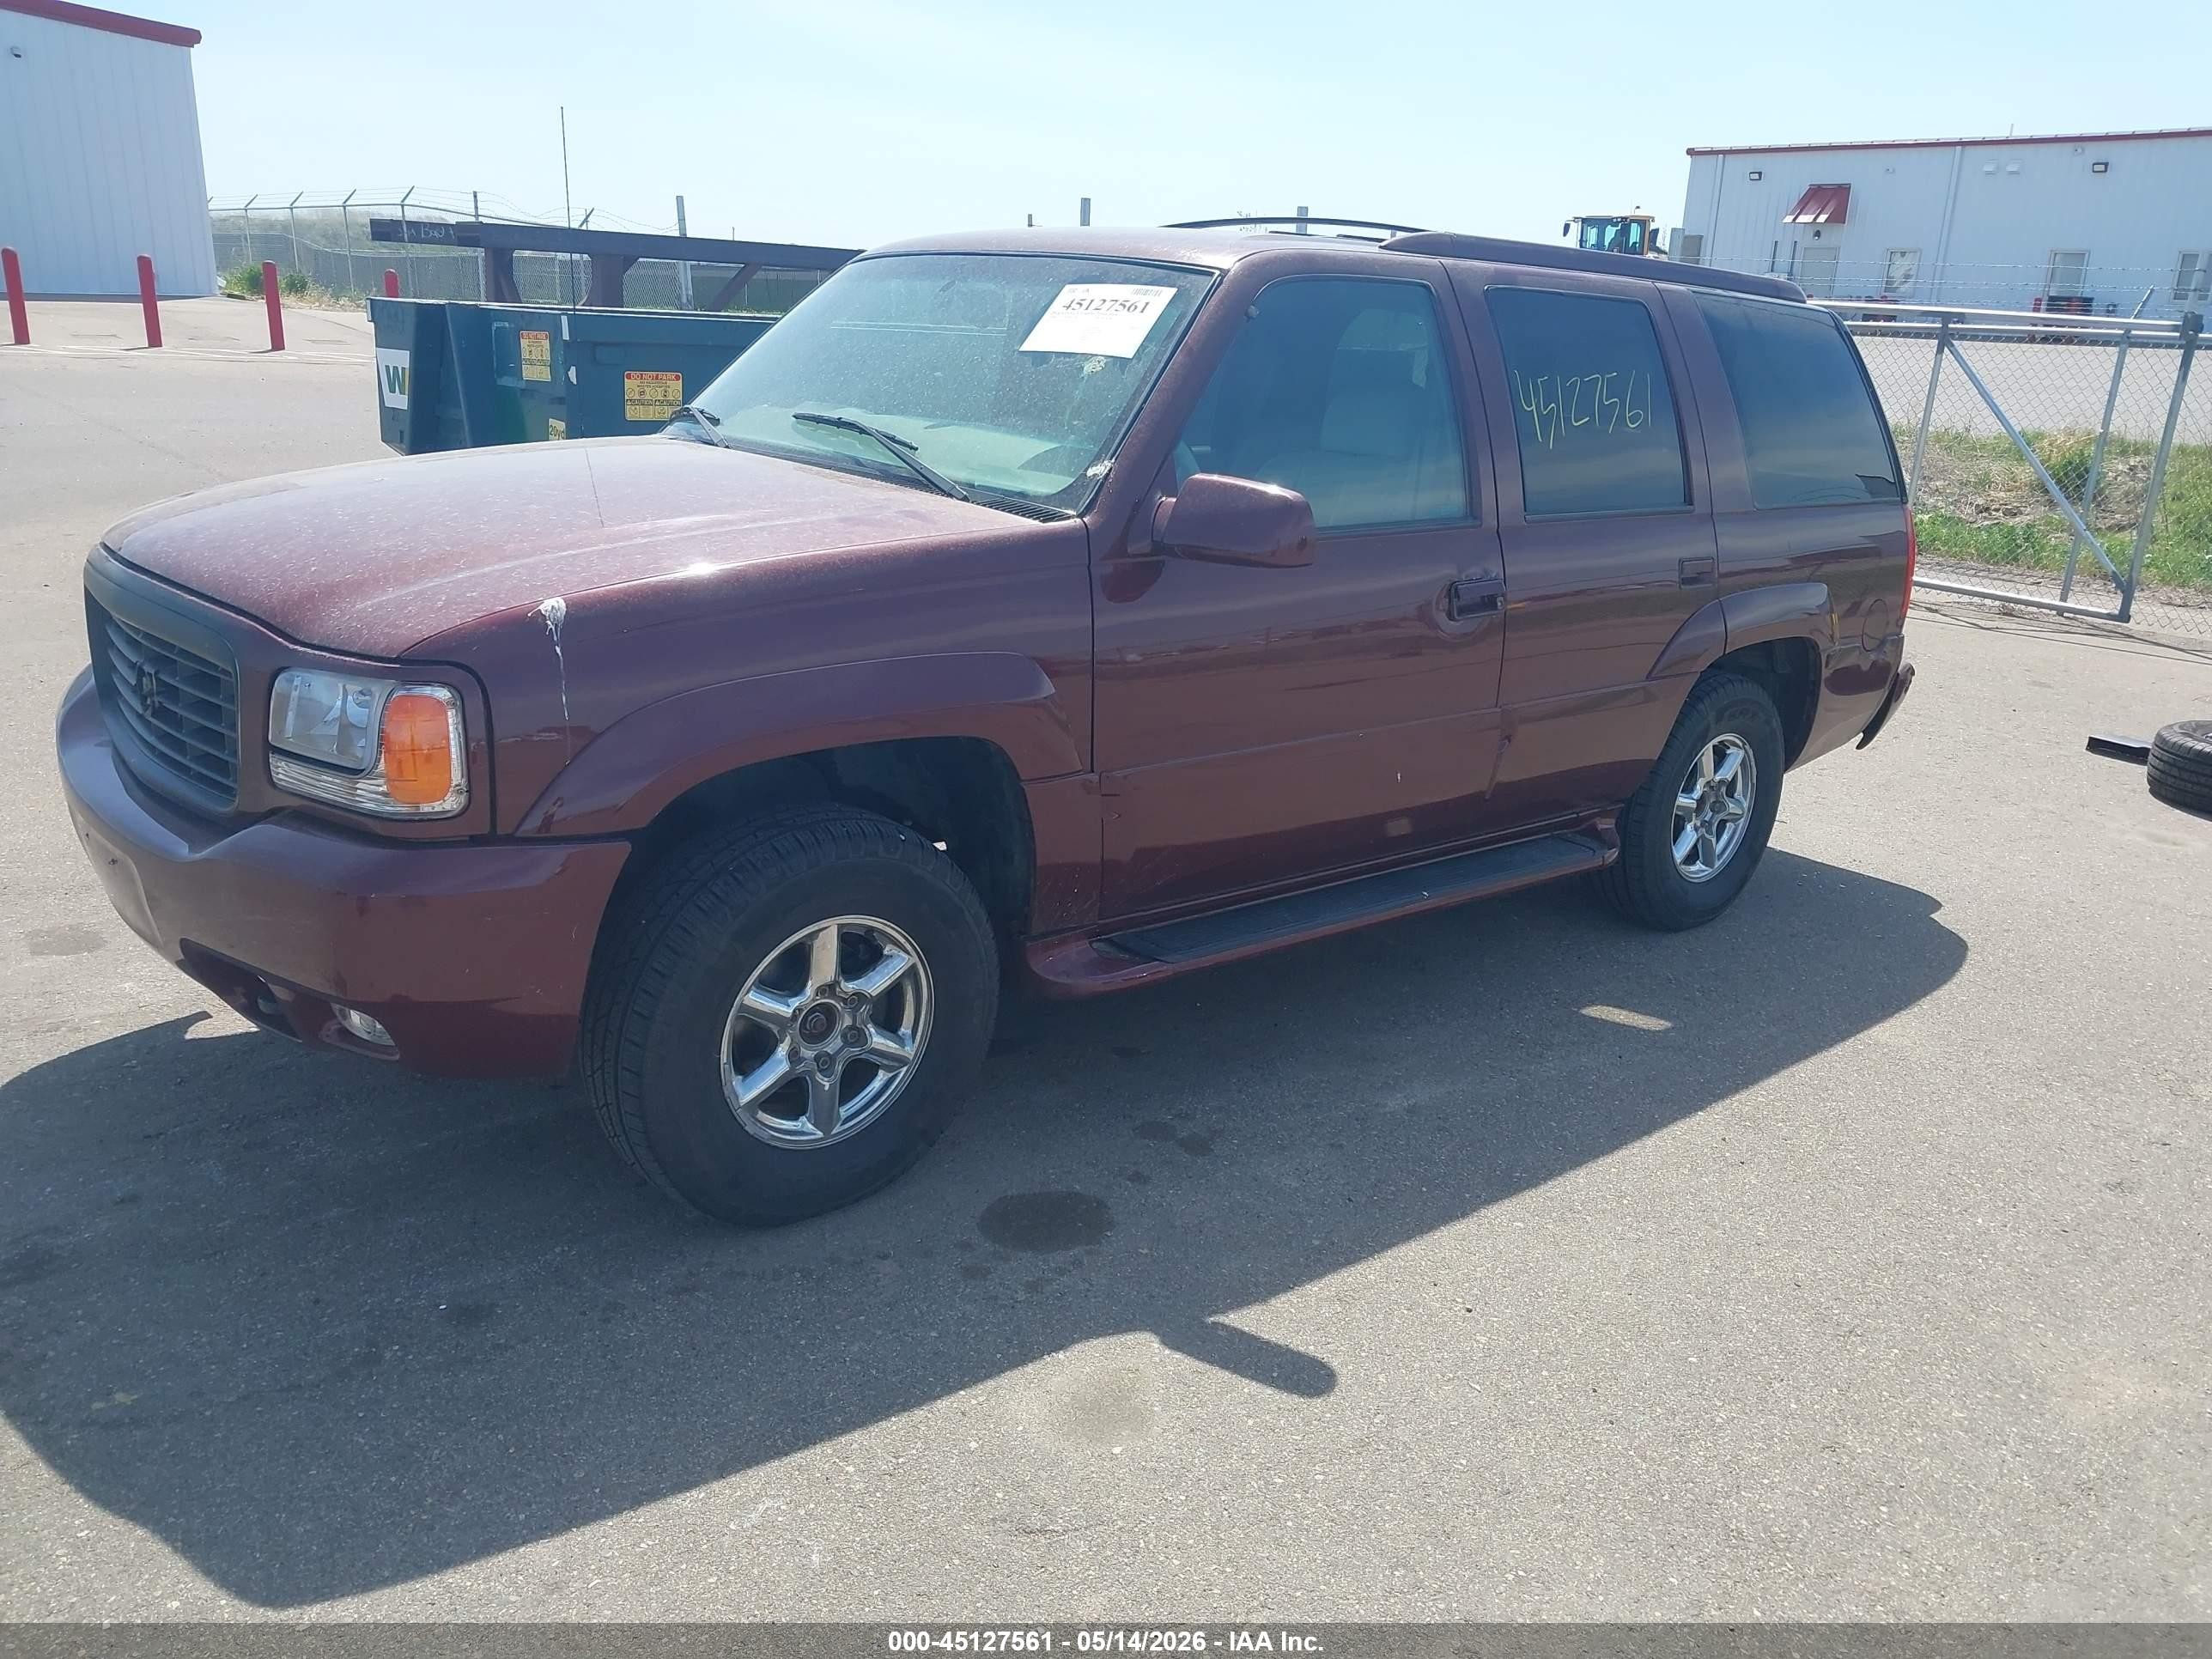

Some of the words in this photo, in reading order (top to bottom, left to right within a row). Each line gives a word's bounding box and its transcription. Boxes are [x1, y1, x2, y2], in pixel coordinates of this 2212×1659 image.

[1062, 298, 1150, 313] 45127561
[1514, 370, 1651, 449] 45127561
[550, 424, 565, 440] 20yd
